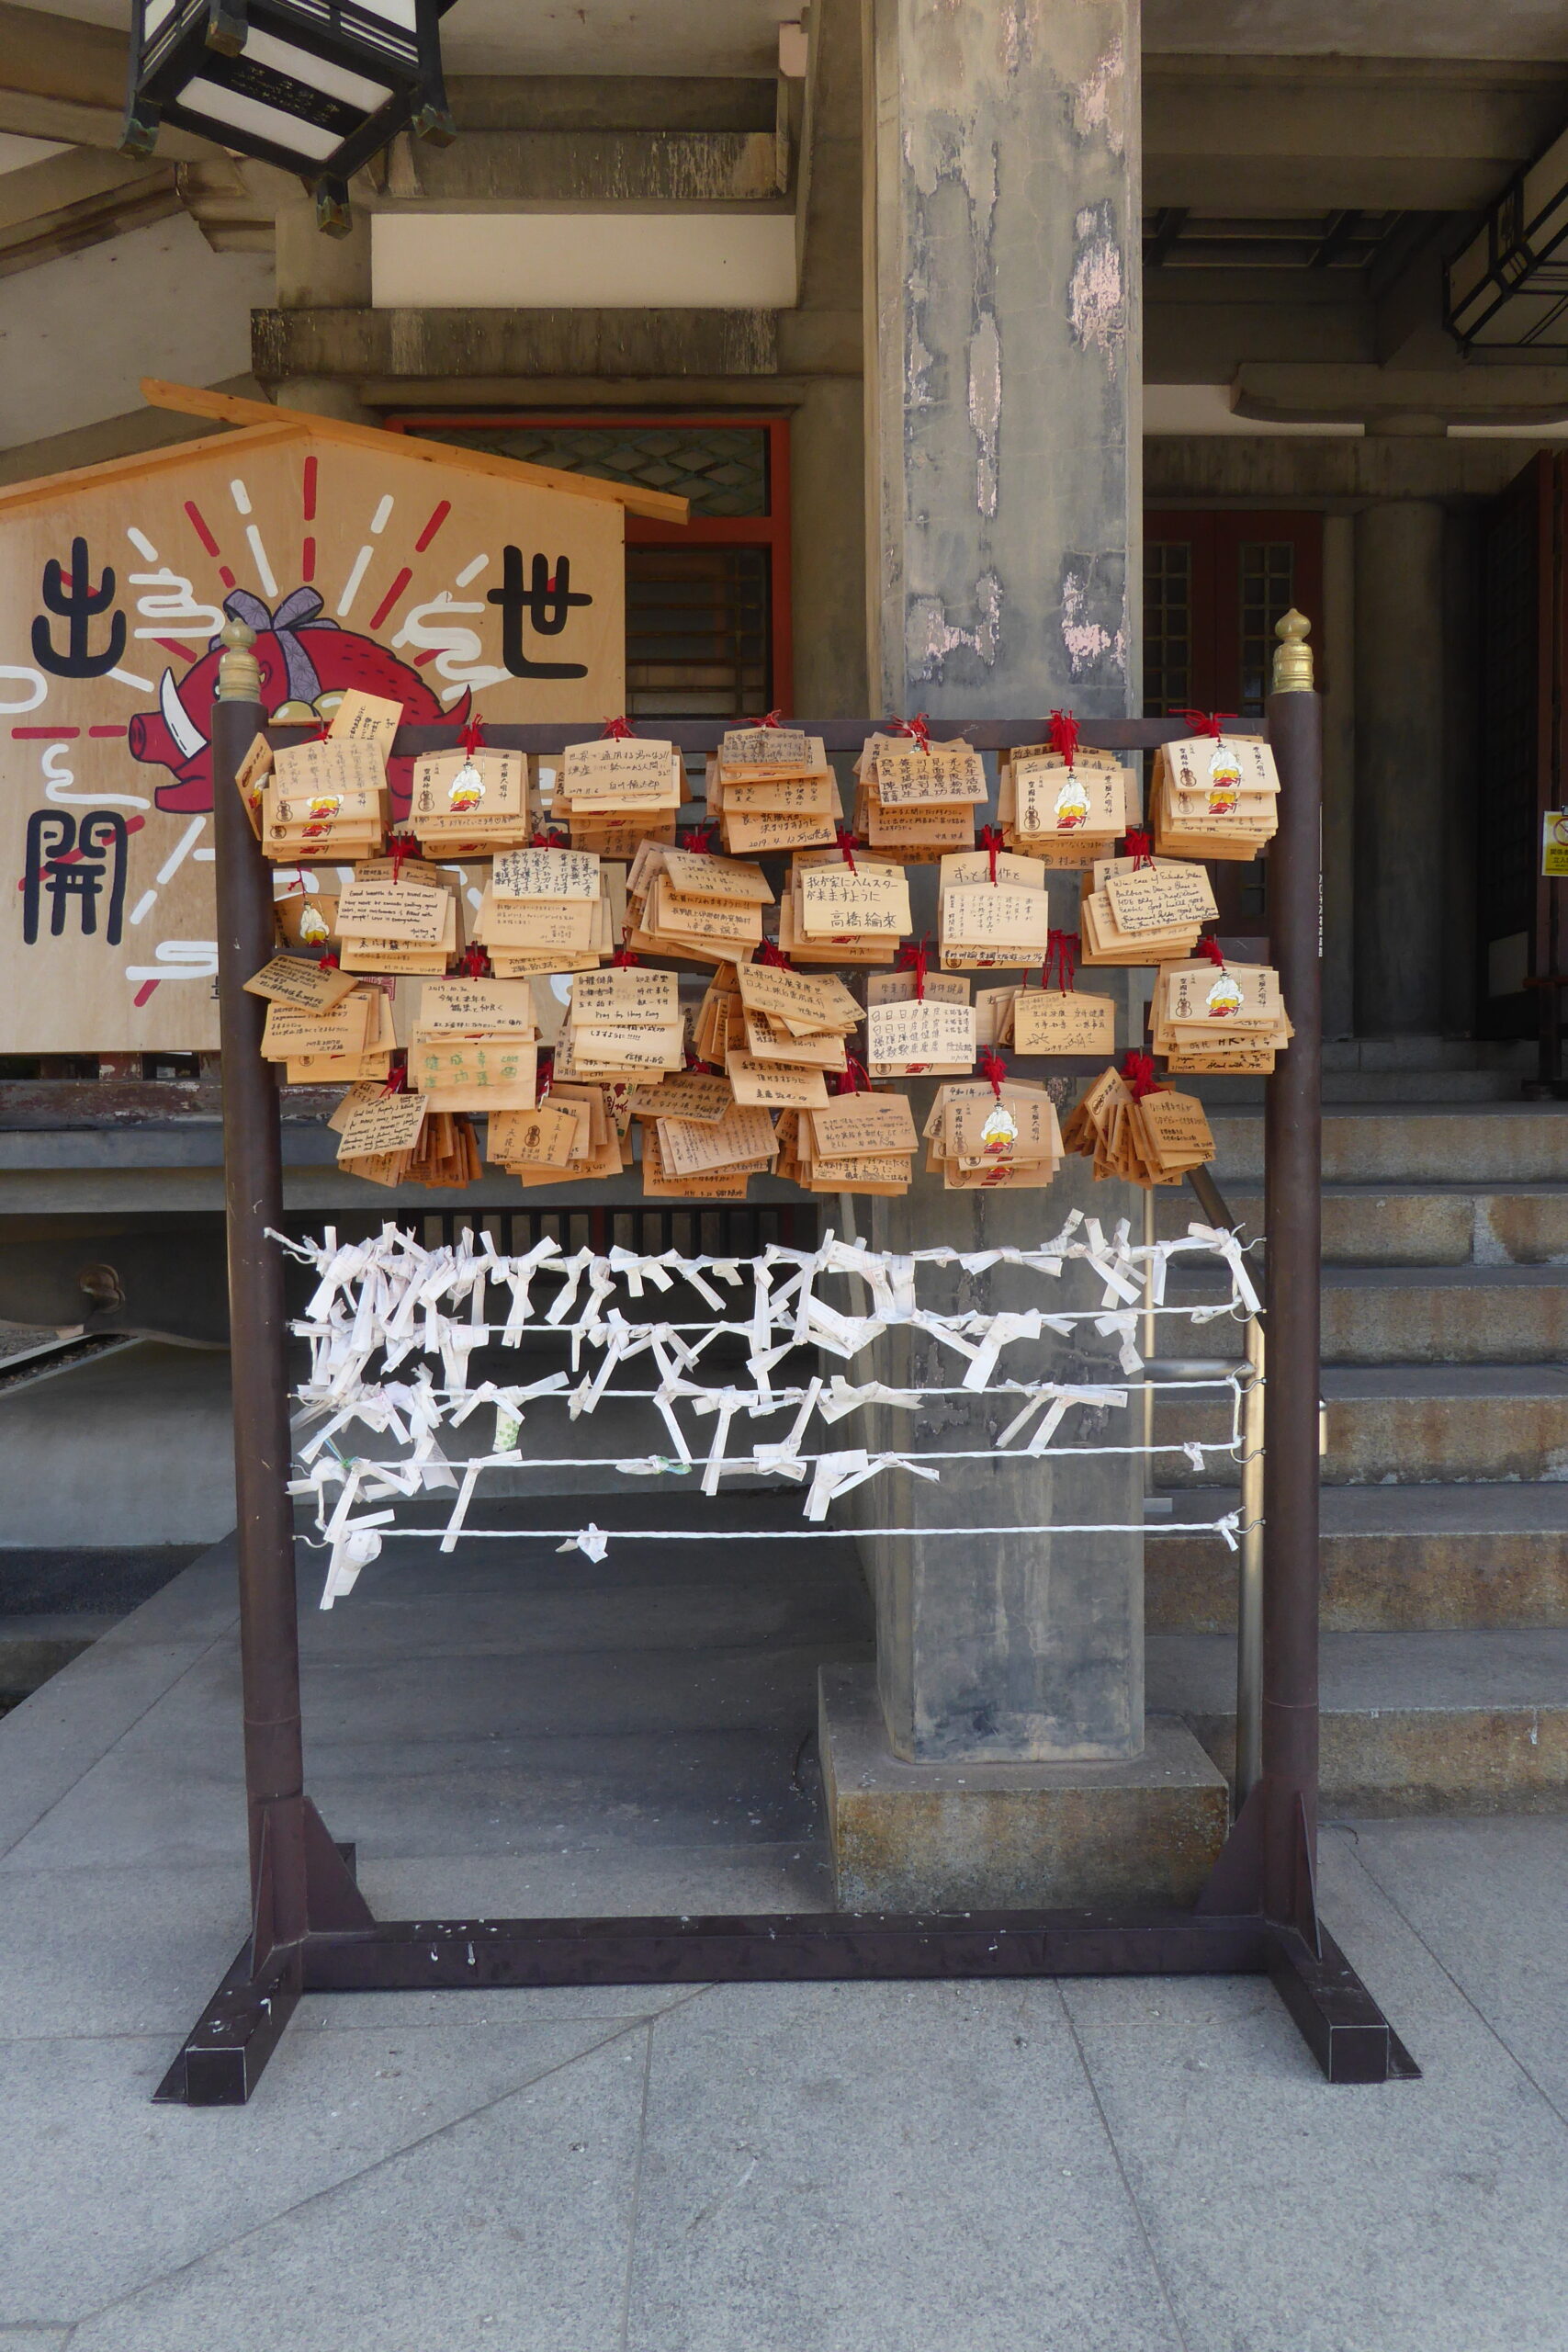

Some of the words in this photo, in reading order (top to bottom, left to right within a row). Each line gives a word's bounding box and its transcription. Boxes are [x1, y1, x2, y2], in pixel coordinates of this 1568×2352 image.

[30, 537, 127, 678] 出
[486, 545, 592, 679] 世
[24, 809, 129, 945] 開
[807, 876, 898, 889] 我が家にハムスター
[807, 888, 881, 902] が来ますように
[646, 1011, 659, 1019] Kong
